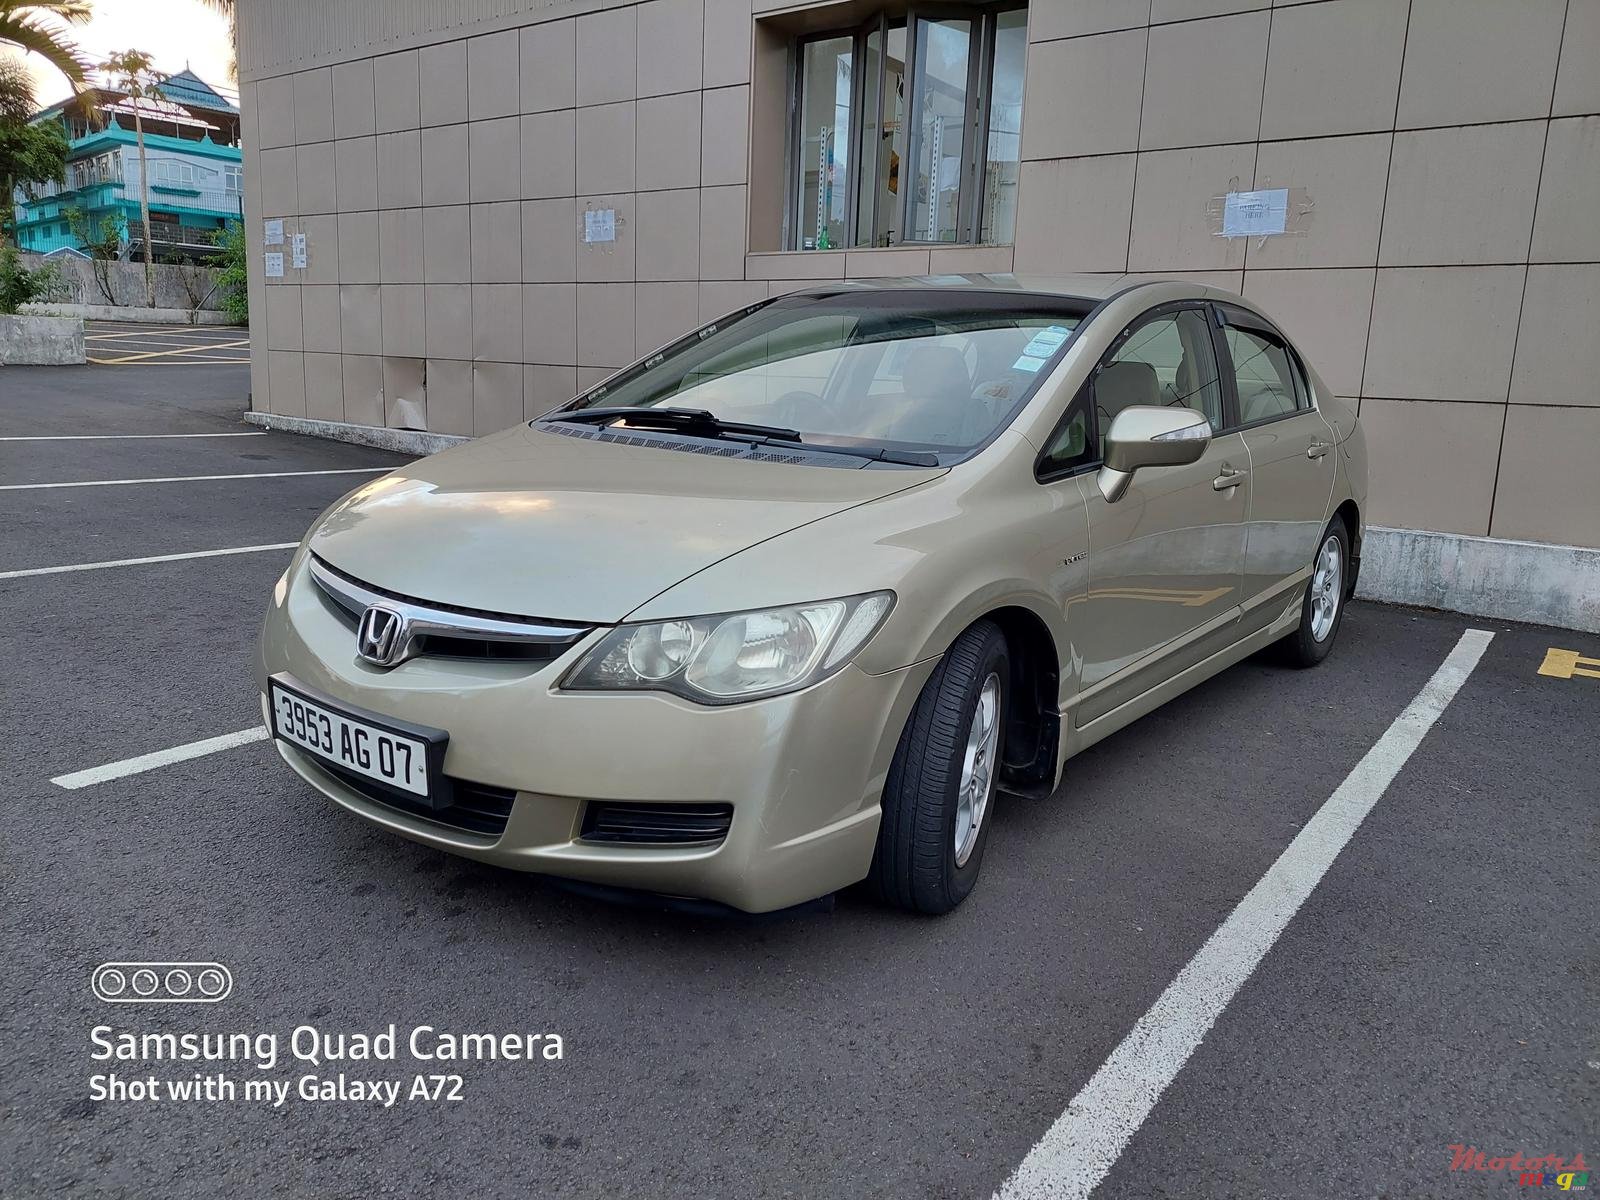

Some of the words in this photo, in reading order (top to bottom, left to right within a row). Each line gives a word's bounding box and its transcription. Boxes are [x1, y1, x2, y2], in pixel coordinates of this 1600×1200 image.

[281, 695, 334, 755] 3953
[340, 722, 371, 770] AG
[378, 736, 412, 785] 07
